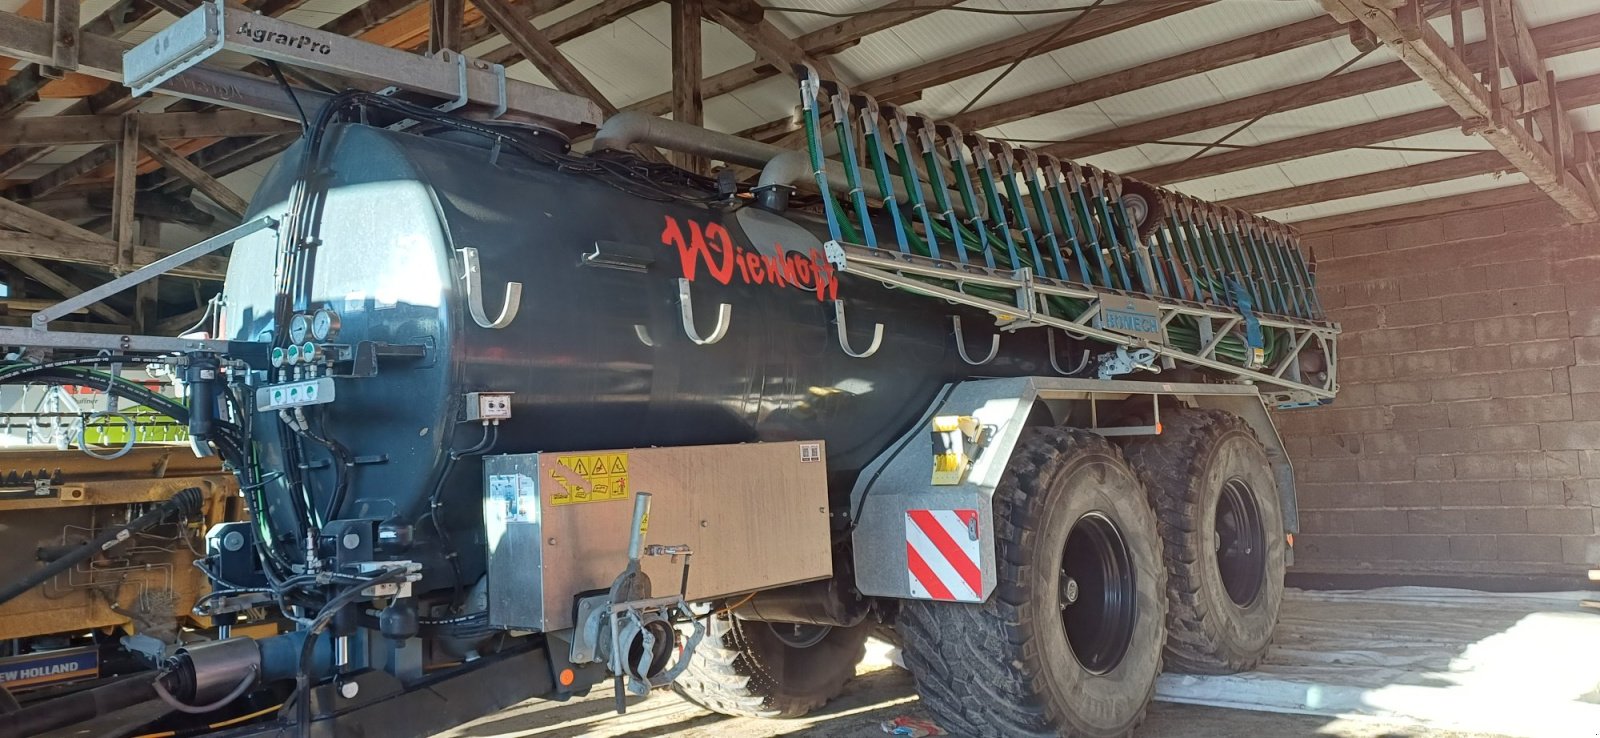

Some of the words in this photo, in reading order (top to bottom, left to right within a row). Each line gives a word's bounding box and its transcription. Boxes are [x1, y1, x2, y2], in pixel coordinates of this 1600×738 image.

[236, 21, 332, 55] AgrarPro
[661, 215, 838, 301] Wienhoff
[0, 670, 18, 682] EW
[20, 661, 79, 679] HOLLAND
